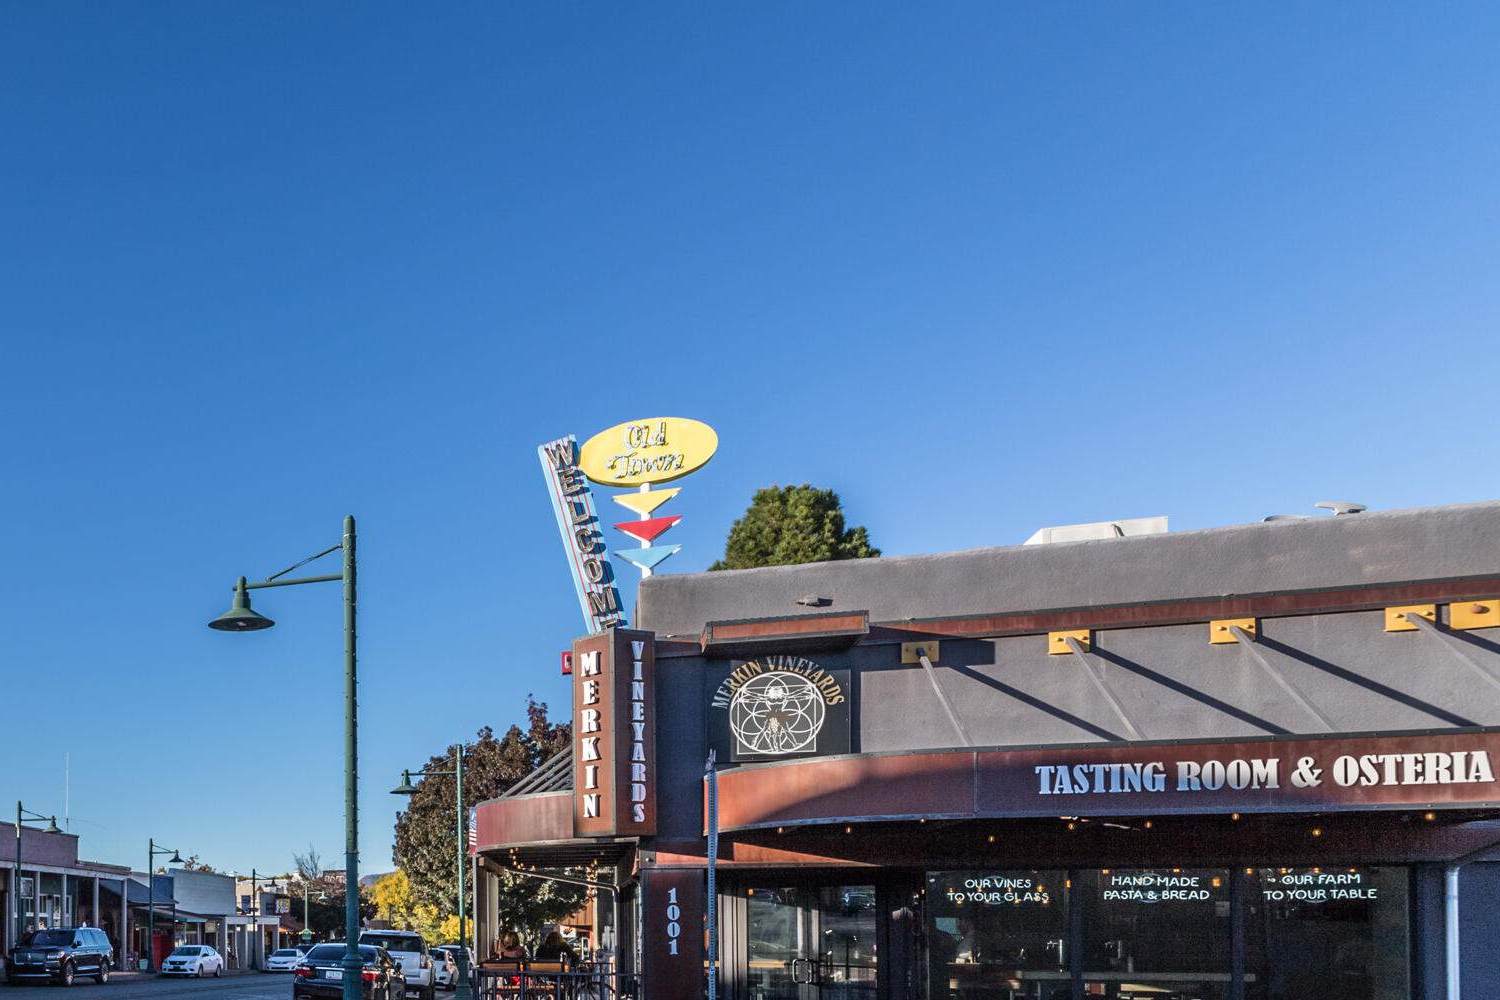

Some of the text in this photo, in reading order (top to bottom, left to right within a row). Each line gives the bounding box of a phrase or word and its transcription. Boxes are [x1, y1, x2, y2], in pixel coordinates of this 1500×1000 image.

[622, 419, 668, 450] Old
[605, 452, 685, 480] Town
[711, 656, 845, 709] MERKIN VINEYARDS
[580, 651, 602, 819] MERKIN
[631, 641, 647, 823] VINEYARDS
[1035, 750, 1496, 794] TASTING ROOM & OSTERIA
[964, 879, 1031, 888] OUR VINES
[1111, 876, 1199, 887] HAND MADE
[1282, 874, 1360, 885] OUR FARM
[947, 892, 1049, 901] TO YOUR GLASS
[1103, 890, 1210, 900] PASTA & BREAD
[1263, 889, 1377, 900] TO YOUR TABLE
[667, 888, 680, 955] 1001
